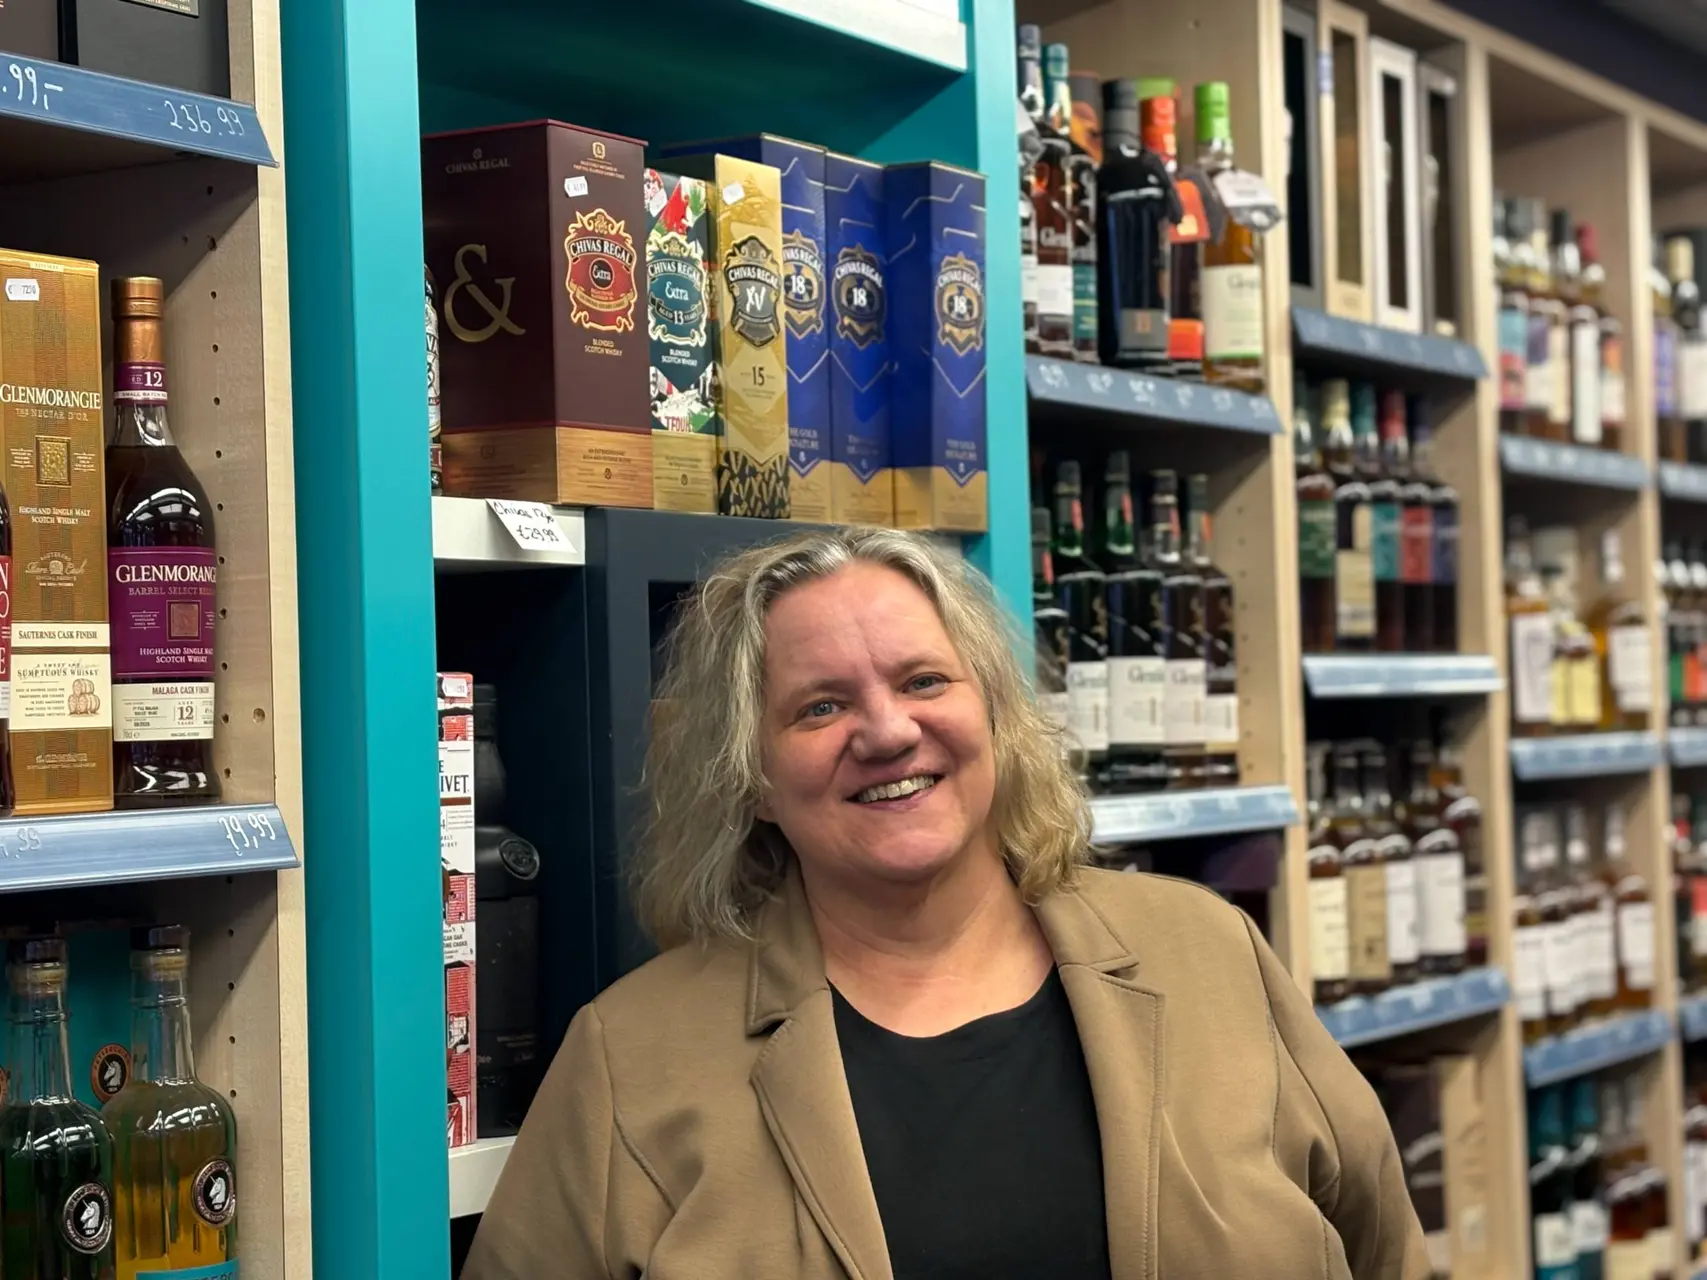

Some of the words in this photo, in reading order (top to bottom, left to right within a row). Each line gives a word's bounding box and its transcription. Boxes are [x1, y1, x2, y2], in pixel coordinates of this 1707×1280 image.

[445, 162, 478, 174] CHIVAS
[479, 158, 511, 170] REGAL
[570, 238, 601, 257] CHIVAS
[603, 240, 633, 266] REGAL
[592, 264, 611, 281] Extra
[648, 261, 676, 277] CHIVAS
[677, 263, 701, 280] REGAL
[728, 266, 756, 281] CHIVAS
[756, 267, 780, 289] REGAL
[835, 262, 861, 279] CHIVAS
[861, 263, 884, 288] REGAL
[665, 281, 689, 300] Extra
[790, 275, 806, 294] 18
[444, 244, 526, 342] &
[745, 286, 766, 312] XV
[852, 288, 868, 307] 18
[953, 295, 968, 314] 18
[674, 310, 685, 325] 13
[592, 338, 614, 348] BLENDED
[584, 345, 605, 354] SCOTCH
[605, 347, 623, 357] WHISKY
[669, 348, 691, 358] BLENDED
[661, 355, 681, 365] SCOTCH
[144, 371, 163, 387] 12
[752, 366, 765, 386] 15
[0, 384, 102, 410] GLENMORANGIE
[31, 409, 65, 420] NECTAR
[18, 506, 51, 515] HIGHLAND
[75, 509, 91, 518] MALT
[31, 516, 55, 525] SCOTCH
[128, 587, 166, 596] BARREL
[168, 586, 197, 595] SELECT
[18, 630, 57, 639] SAUTERNES
[58, 631, 74, 639] CASK
[76, 630, 98, 639] FINISH
[140, 648, 181, 656] HIGHLAND
[187, 655, 208, 663] WHISKY
[17, 669, 67, 677] SUMPTUOUS
[70, 668, 99, 677] WHISKY
[152, 687, 179, 695] MALAGA
[180, 686, 195, 694] CASK
[177, 705, 194, 720] 12
